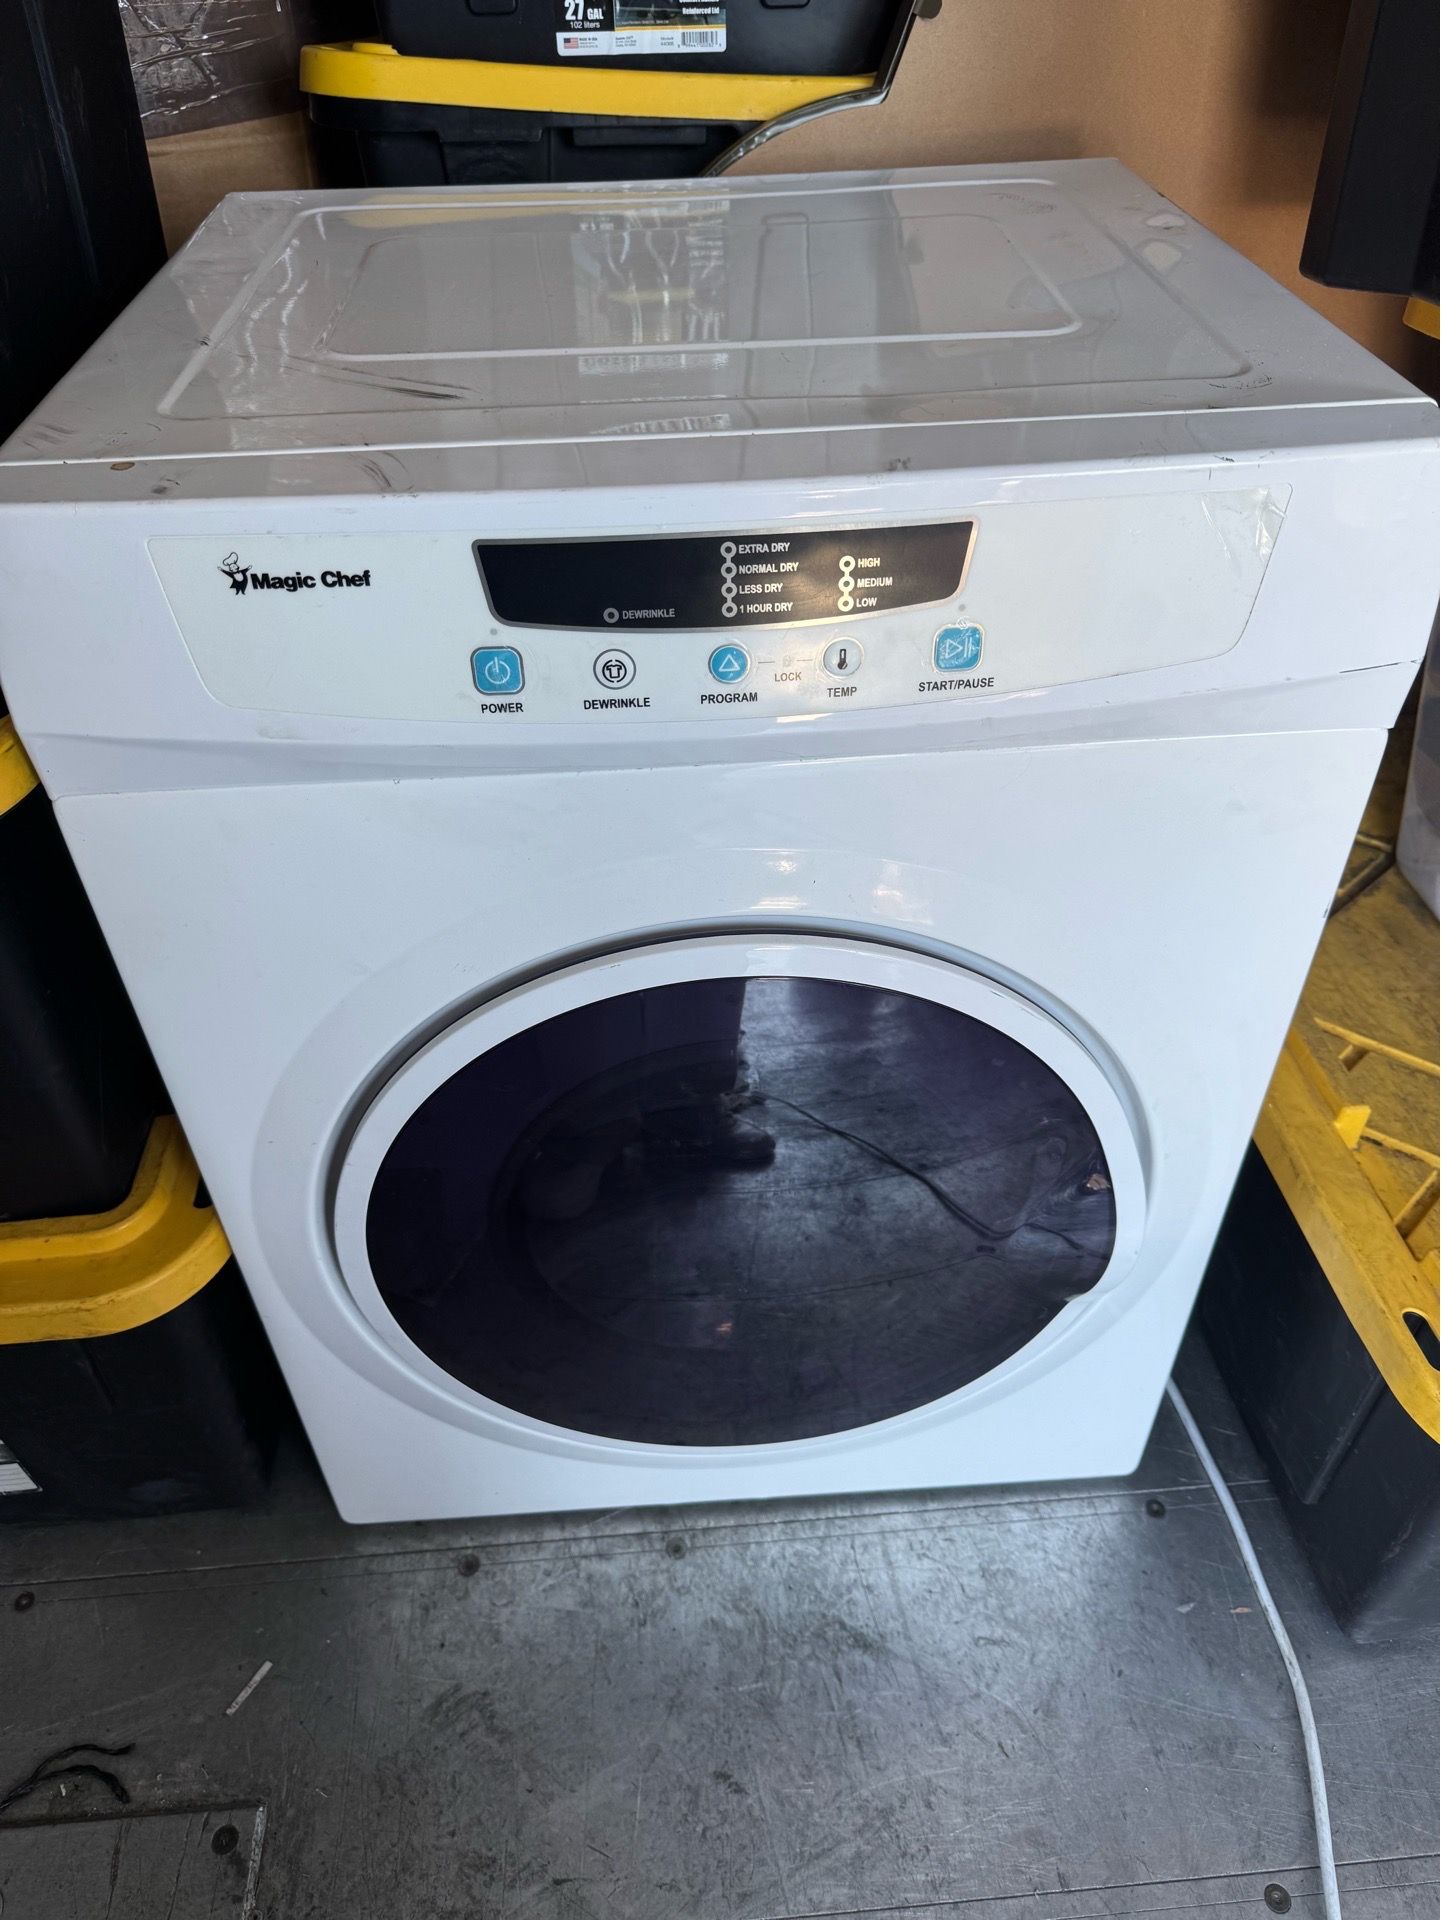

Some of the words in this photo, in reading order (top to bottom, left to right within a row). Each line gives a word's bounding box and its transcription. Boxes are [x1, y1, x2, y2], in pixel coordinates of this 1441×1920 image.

[564, 0, 585, 20] 27
[587, 8, 604, 20] GAL
[682, 7, 711, 15] Reinforced
[570, 21, 583, 29] 102
[583, 21, 601, 29] liters
[738, 544, 769, 554] EXTRA
[770, 542, 790, 552] DRY
[738, 564, 778, 575] NORMAL
[779, 562, 799, 573] DRY
[857, 557, 881, 568] HIGH
[250, 572, 316, 592] Magic
[321, 569, 371, 588] Chef
[856, 577, 893, 589] MEDIUM
[738, 584, 763, 594] LESS
[764, 583, 784, 594] DRY
[739, 605, 745, 614] 1
[746, 603, 774, 614] HOUR
[774, 602, 794, 612] DRY
[855, 598, 878, 608] LOW
[622, 608, 676, 620] DEWRINKLE
[774, 671, 802, 683] LOCK
[918, 677, 995, 692] START/PAUSE
[700, 691, 758, 705] PROGRAM
[827, 686, 857, 698] TEMP
[480, 702, 524, 714] POWER
[583, 697, 651, 710] DEWRINKLE
